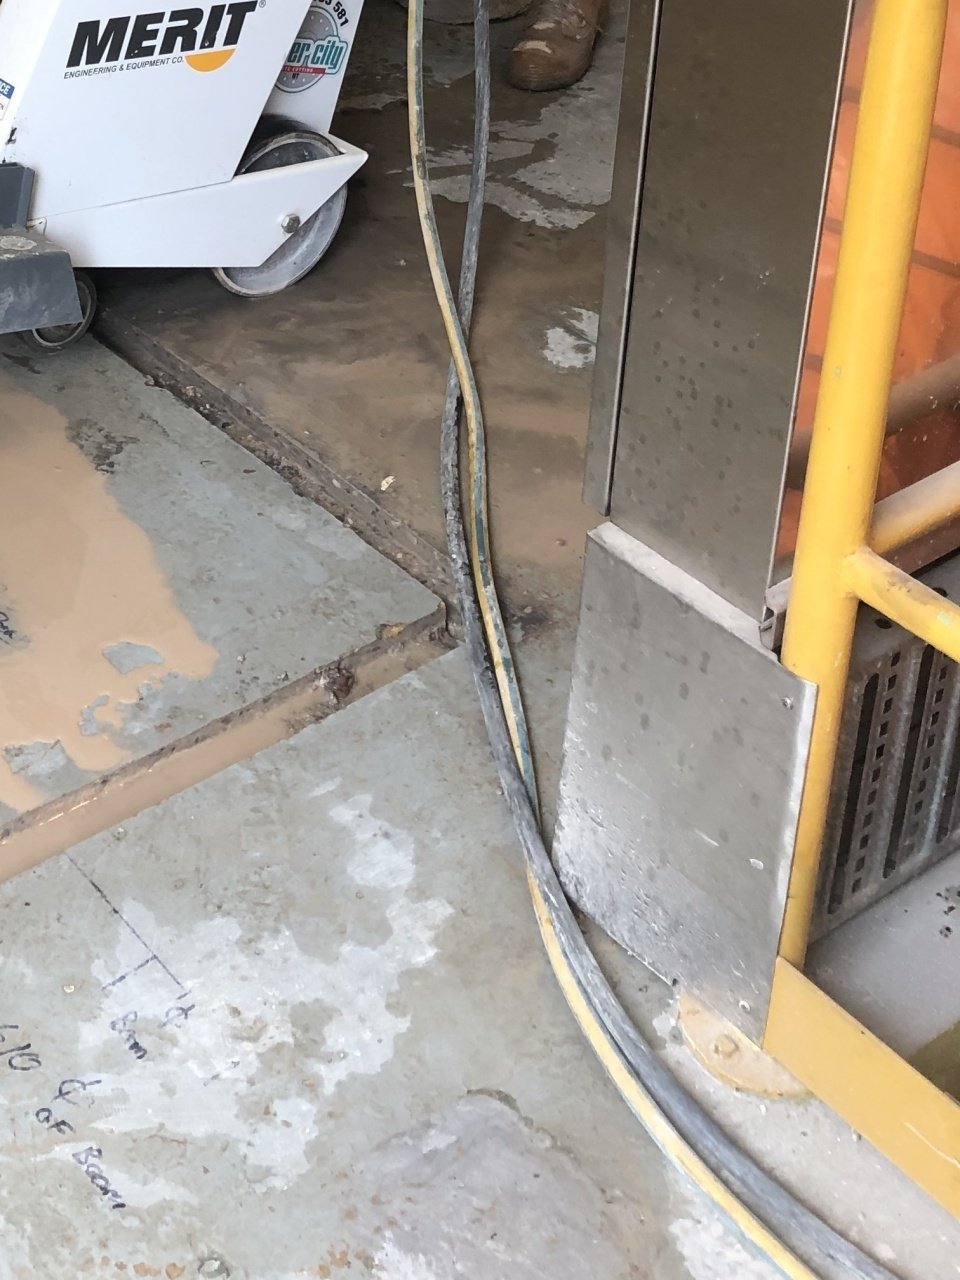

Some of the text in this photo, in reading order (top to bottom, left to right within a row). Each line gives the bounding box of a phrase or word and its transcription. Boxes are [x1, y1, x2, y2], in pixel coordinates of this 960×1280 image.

[333, 1, 349, 27] 581
[66, 0, 258, 68] MERIT
[64, 64, 117, 79] ENGINEERING
[126, 57, 170, 71] EQUIPMENT
[310, 40, 344, 70] city
